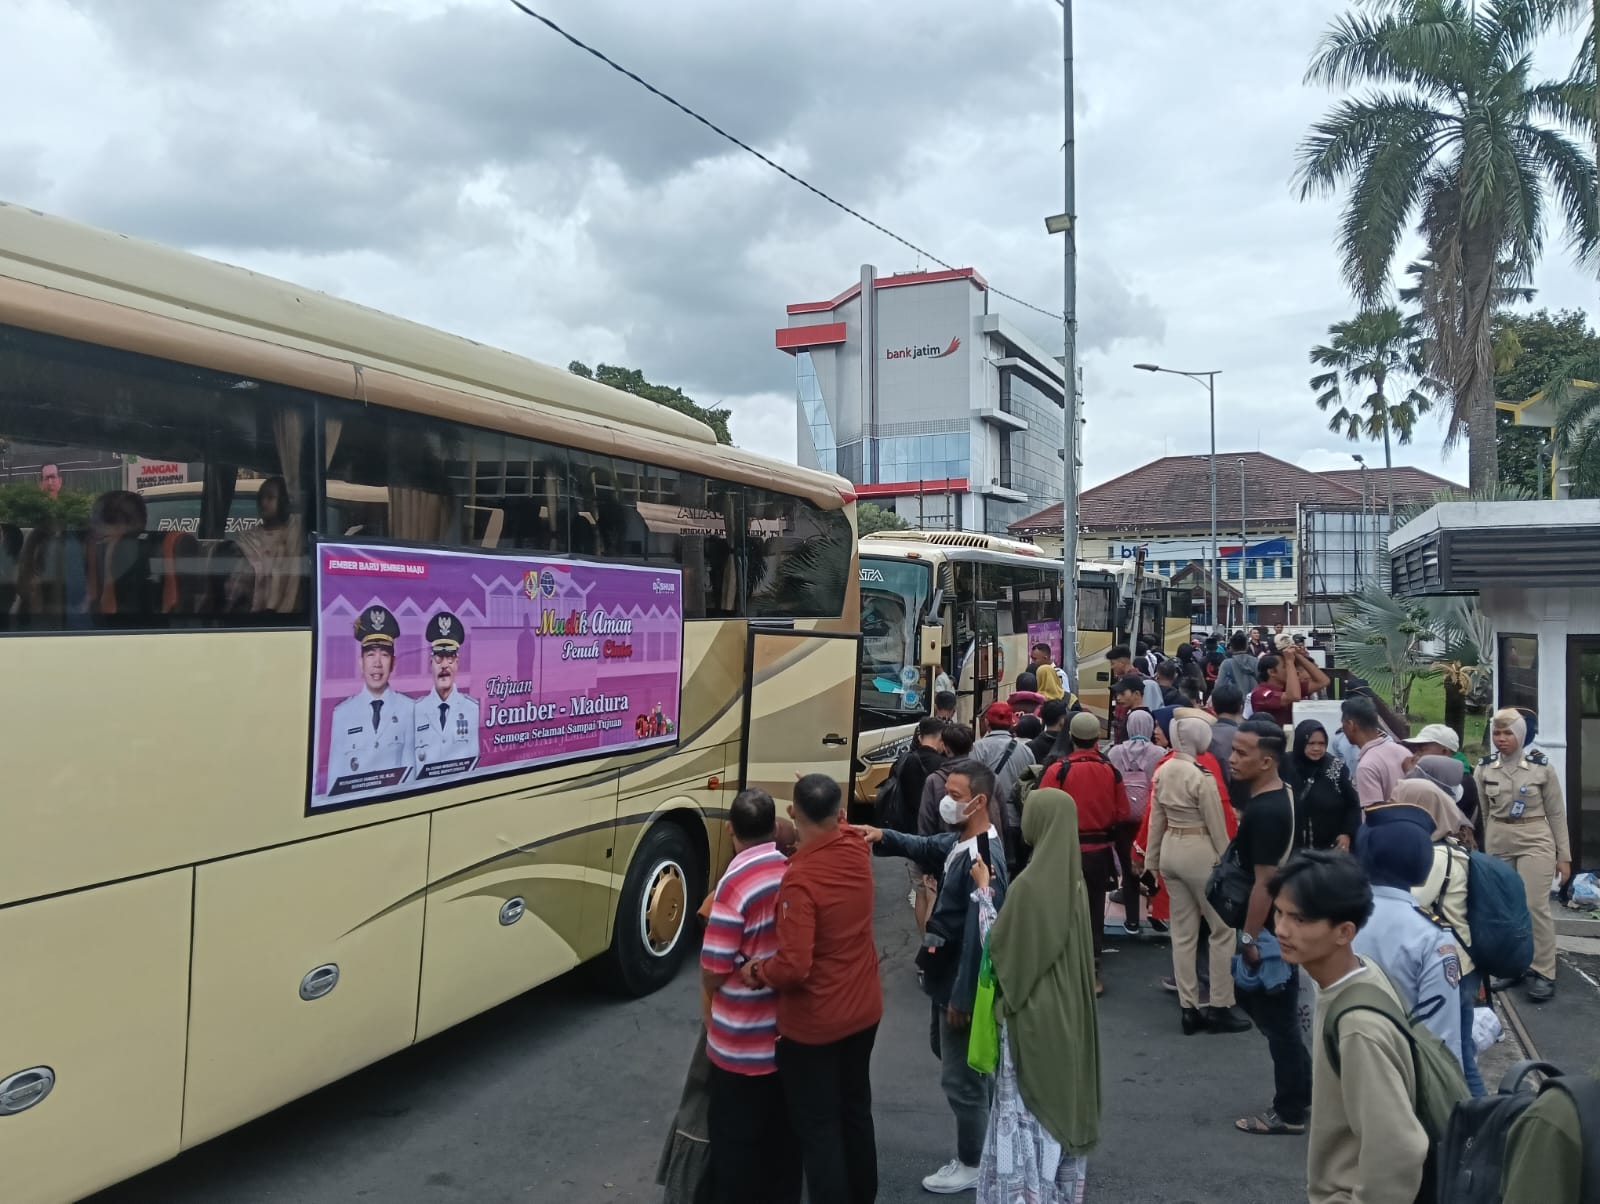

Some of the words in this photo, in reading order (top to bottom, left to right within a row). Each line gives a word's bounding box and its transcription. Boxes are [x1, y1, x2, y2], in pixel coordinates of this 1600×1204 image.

[886, 349, 912, 360] bank
[913, 344, 940, 360] jatim
[141, 464, 178, 475] JANGAN
[158, 474, 184, 483] SAMPAH
[329, 559, 358, 570] JEMBER
[358, 561, 380, 571] BARU
[380, 563, 406, 573] JEMBER
[406, 564, 425, 574] MAJU
[535, 609, 588, 636] Mudik
[591, 610, 633, 635] Aman
[562, 640, 600, 660] Penuh
[486, 675, 533, 701] Tujuan
[486, 701, 557, 728] Jember
[569, 693, 630, 718] Madura
[493, 732, 530, 745] Semoga
[531, 725, 566, 739] Selamat
[567, 720, 596, 735] Sampai
[597, 717, 622, 731] Tujuan
